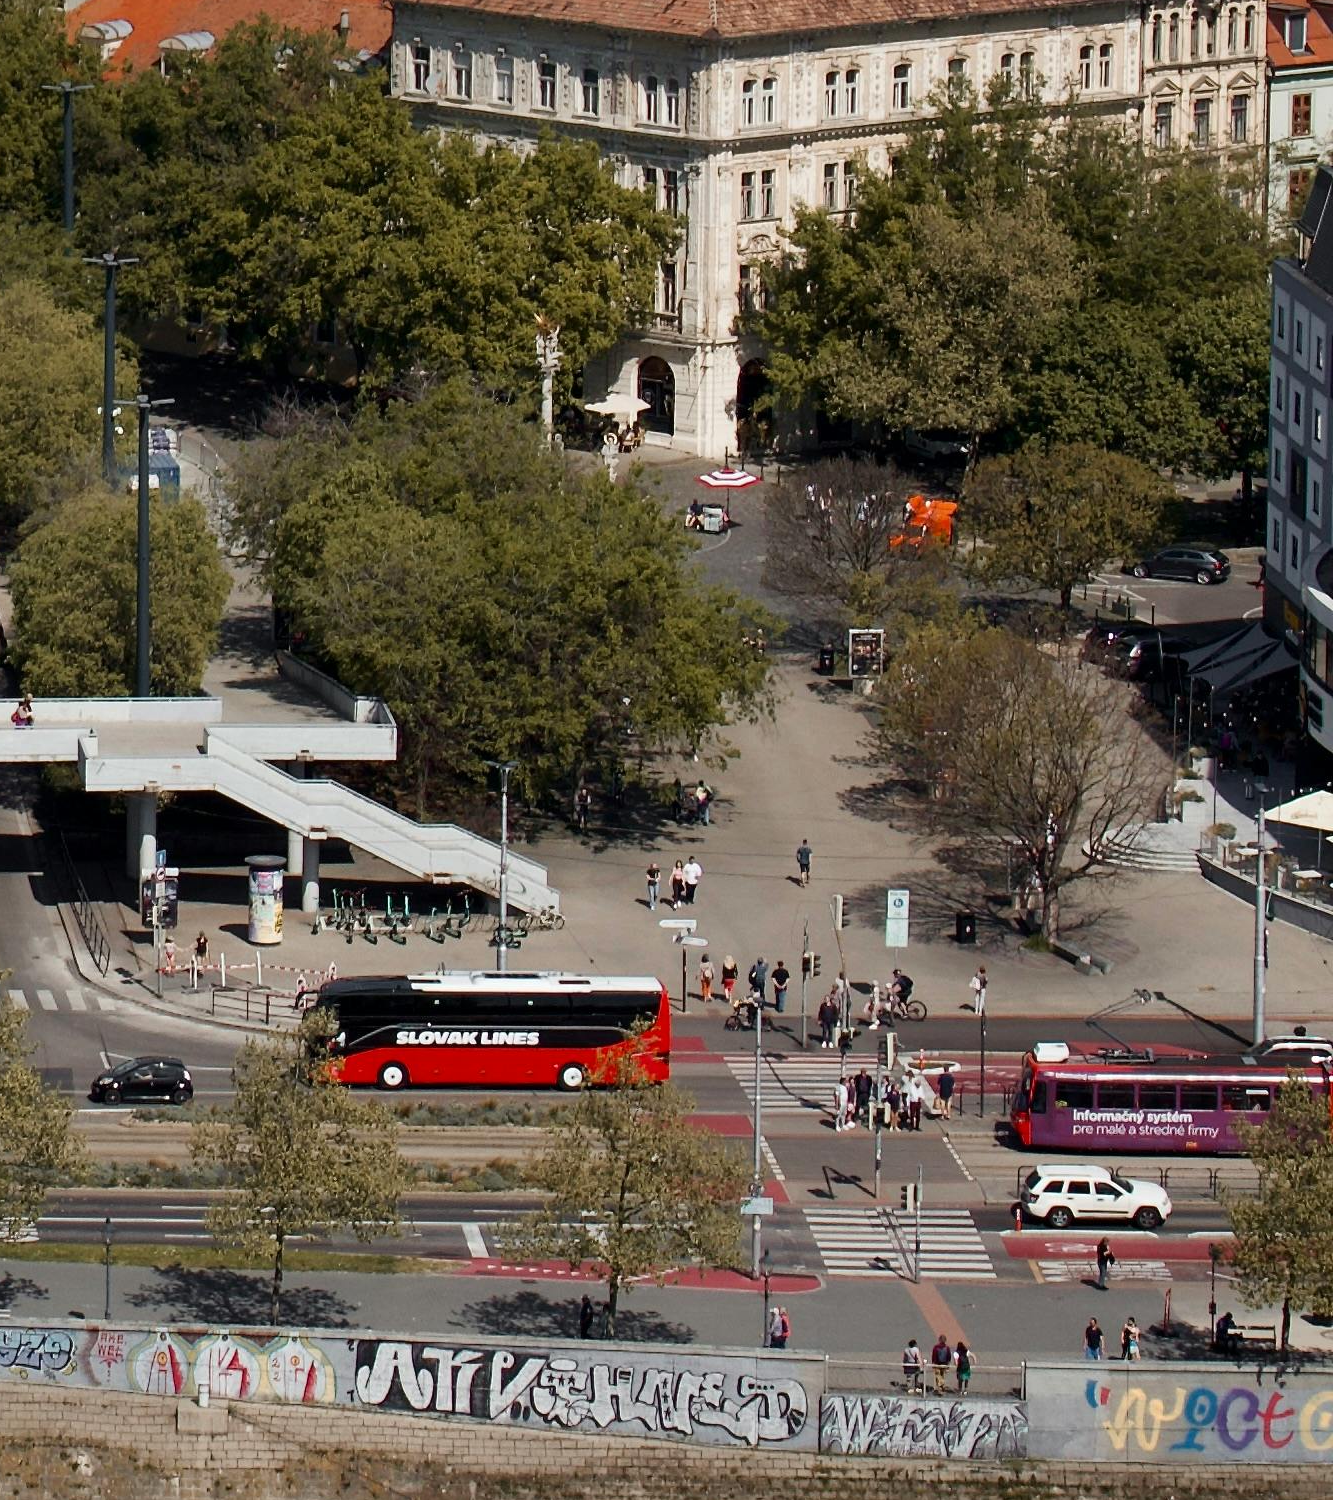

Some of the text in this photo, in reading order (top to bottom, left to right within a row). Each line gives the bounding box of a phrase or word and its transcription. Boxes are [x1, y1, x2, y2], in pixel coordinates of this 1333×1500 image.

[396, 1031, 540, 1046] SLOVAK LINES
[1073, 1109, 1193, 1125] Informačný systém
[1073, 1123, 1220, 1138] pre malé a stredné firmy
